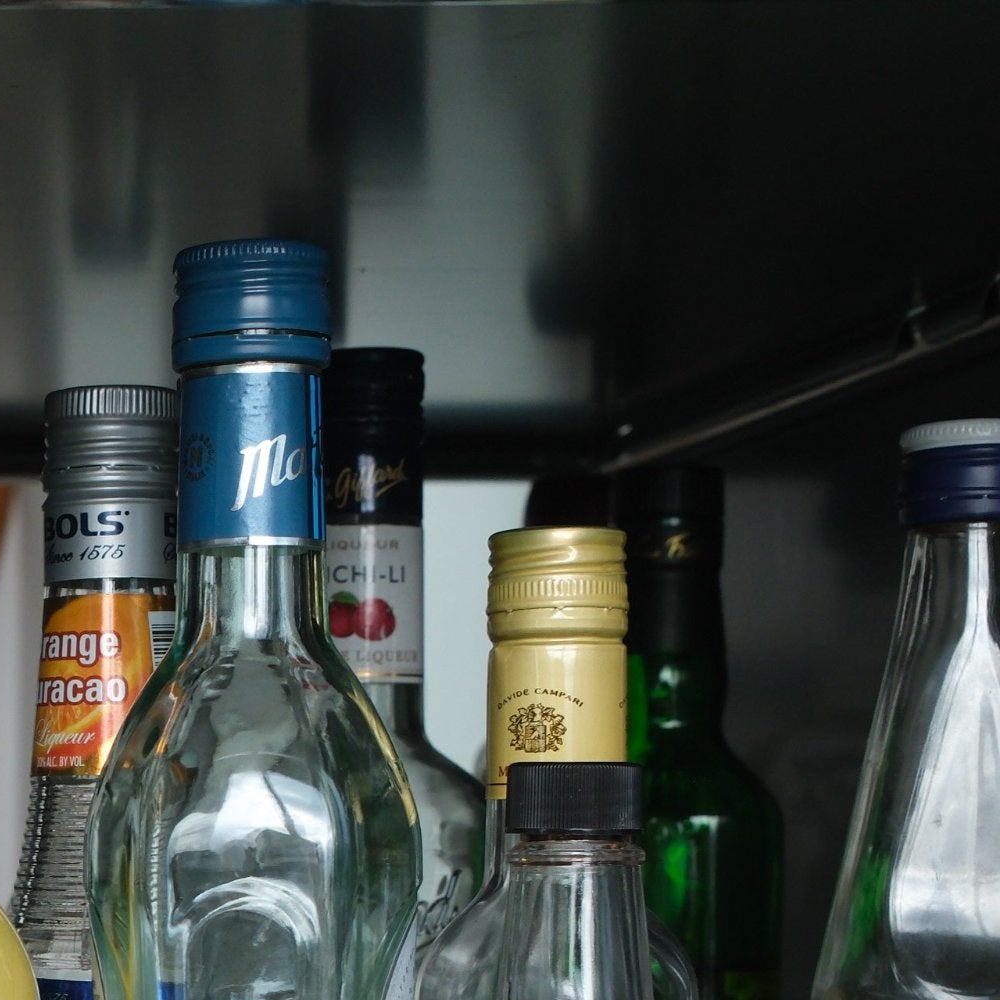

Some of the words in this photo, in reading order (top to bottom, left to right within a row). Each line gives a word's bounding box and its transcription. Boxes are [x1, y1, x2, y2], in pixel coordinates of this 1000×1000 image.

[80, 544, 126, 561] 1575
[41, 632, 120, 666] range
[497, 688, 530, 710] DAVIDE
[534, 687, 584, 708] CAMPARI
[35, 719, 95, 754] Liqueur
[59, 755, 68, 767] BY
[69, 755, 85, 767] VOL.
